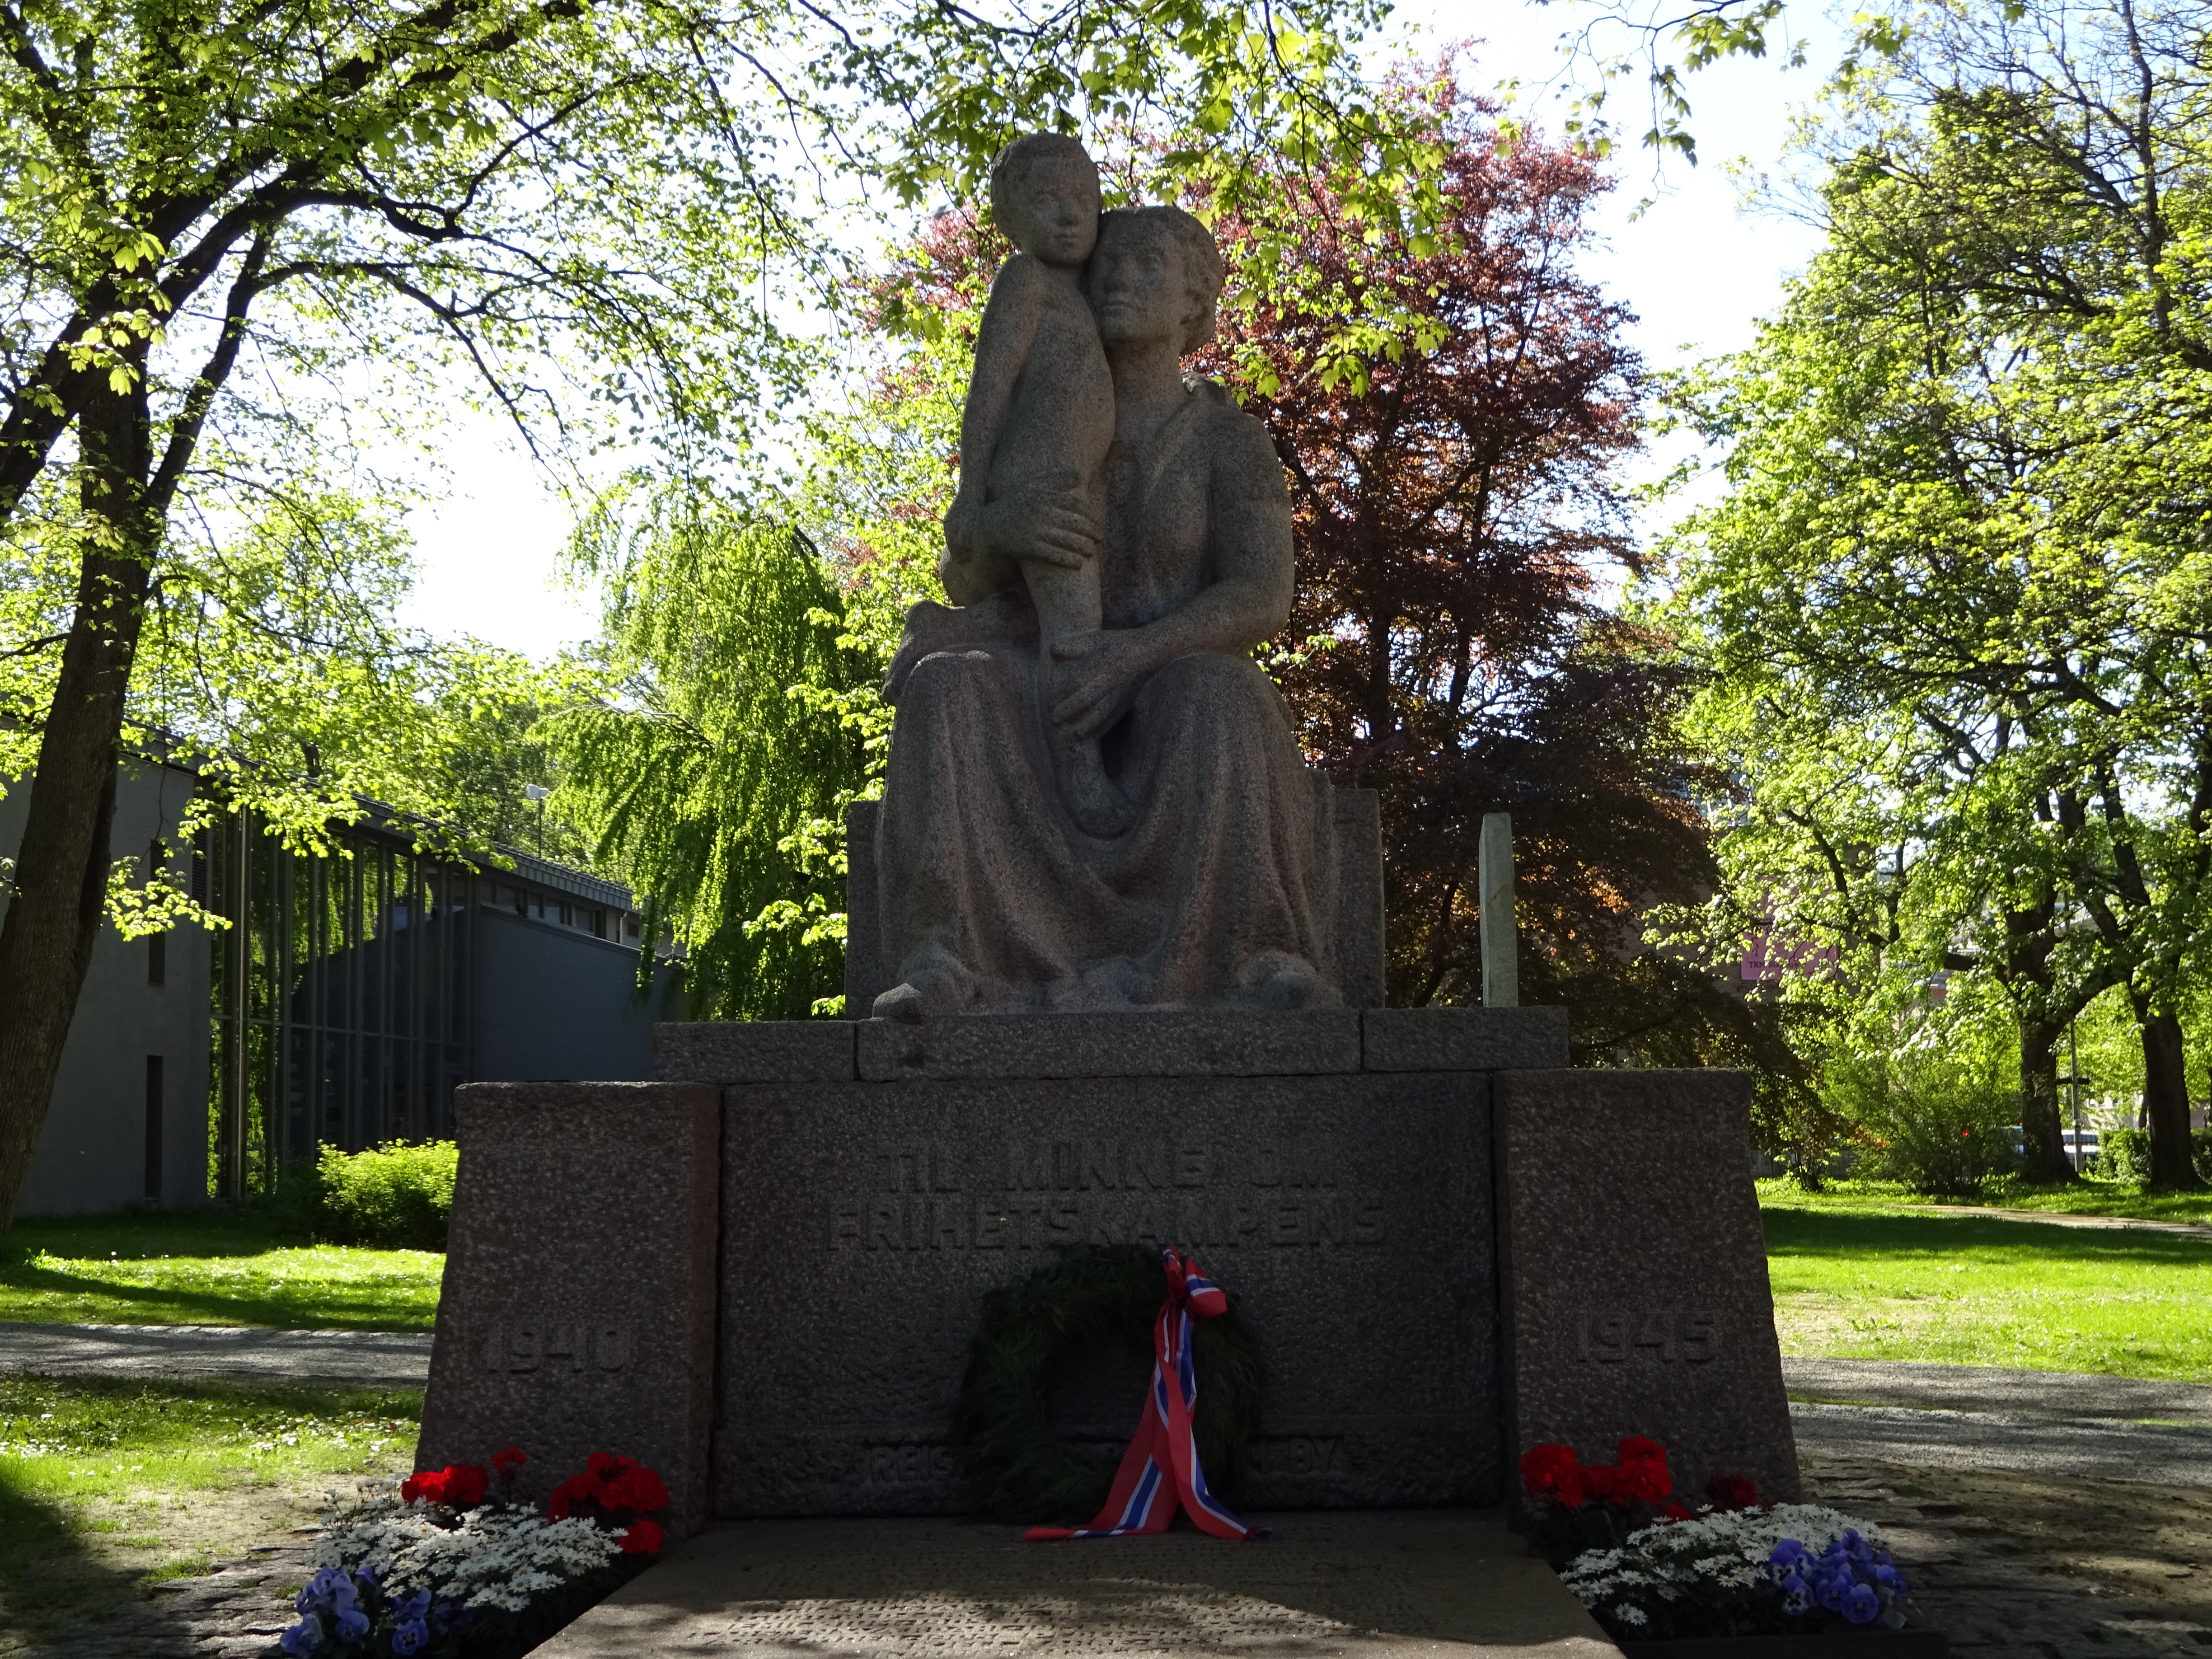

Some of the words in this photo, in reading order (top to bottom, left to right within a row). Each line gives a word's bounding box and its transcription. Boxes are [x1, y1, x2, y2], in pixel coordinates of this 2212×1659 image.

[876, 1146, 962, 1193] TIL
[1006, 1142, 1205, 1191] MINNE
[1247, 1141, 1336, 1189] OM
[827, 1200, 1387, 1251] FRIHETSKAMPENS
[484, 1323, 632, 1373] 1940
[1572, 1311, 1719, 1363] 1945
